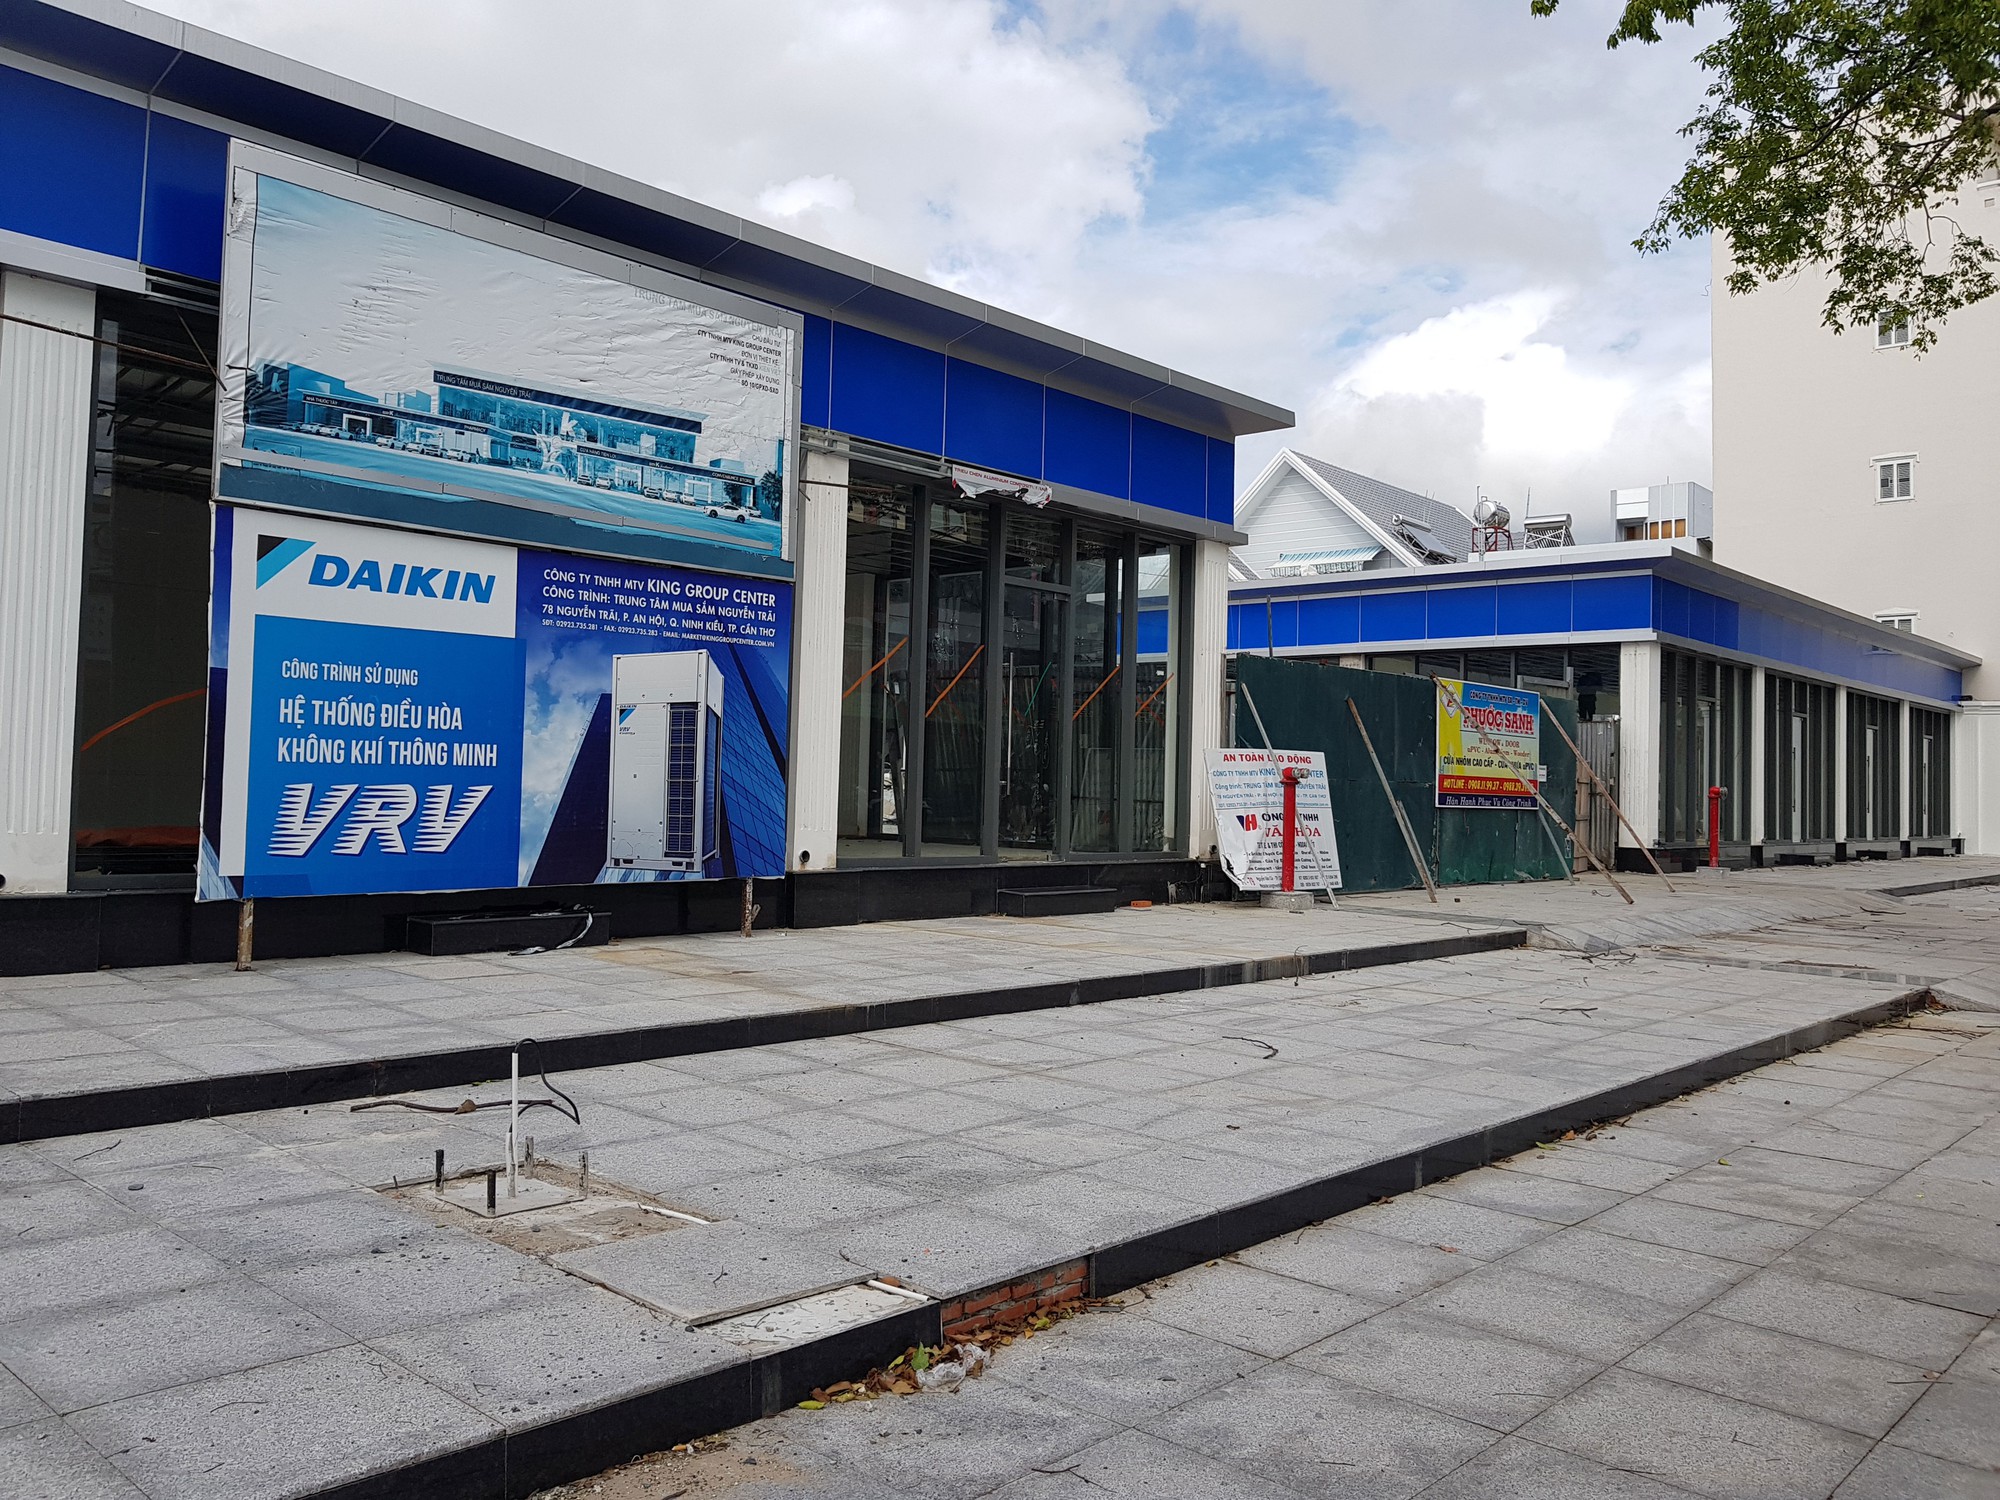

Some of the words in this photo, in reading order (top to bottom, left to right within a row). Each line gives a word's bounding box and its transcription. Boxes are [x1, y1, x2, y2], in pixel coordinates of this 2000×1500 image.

[732, 338, 745, 347] KING
[746, 342, 762, 351] GROUP
[763, 347, 782, 357] CENTER
[437, 374, 456, 384] TRUNG
[308, 554, 496, 604] DAIKIN
[544, 568, 576, 583] CÔNG
[579, 573, 591, 585] TY
[594, 576, 621, 588] TNHH
[624, 579, 645, 591] MTV
[647, 579, 681, 595] KING
[685, 584, 729, 601] GROUP
[733, 589, 776, 607] CENTER
[543, 585, 575, 600] CÔNG
[578, 589, 611, 604] TRÌNH:
[614, 594, 647, 607] TRUNG
[650, 597, 669, 610] TÂM
[672, 601, 693, 613] MUA
[696, 601, 716, 616] SẮM
[718, 606, 755, 620] NGUYỄN
[758, 611, 776, 623] TRÃI
[542, 604, 554, 615] 78
[557, 605, 596, 619] NGUYỄN
[599, 609, 621, 623] TRÃI,
[623, 612, 630, 623] P.
[633, 614, 646, 624] AN
[649, 614, 667, 629] HỘI,
[670, 617, 679, 628] Q.
[682, 619, 704, 630] NINH
[728, 624, 738, 634] TP.
[740, 623, 757, 636] CẦN
[759, 628, 776, 638] THƠ
[556, 621, 598, 631] 02923.735.281
[604, 625, 617, 633] FAX:
[618, 626, 658, 637] 02923.735.283
[663, 631, 681, 639] EMAIL:
[282, 658, 318, 680] CÔNG
[322, 661, 362, 683] TRÌNH
[365, 662, 382, 685] SỬ
[385, 667, 419, 688] DỤNG
[279, 694, 306, 729] HỆ
[311, 695, 376, 728] THỐNG
[380, 698, 422, 729] ĐIỀU
[427, 702, 463, 731] HÒA
[1505, 711, 1535, 732] SANH
[277, 733, 345, 765] KHÔNG
[351, 736, 385, 765] KHÍ
[389, 737, 448, 766] THÔNG
[452, 743, 498, 767] MINH
[1505, 740, 1520, 748] DOOR
[1224, 754, 1237, 762] AN
[1239, 752, 1265, 762] TOÀN
[1287, 754, 1312, 765] ĐỘNG
[1472, 759, 1483, 768] CAO
[1484, 757, 1494, 768] CẤP
[1213, 769, 1228, 777] CÔNG
[1259, 768, 1276, 776] KING
[1443, 779, 1465, 789] HOTLINE
[266, 782, 495, 858] VRV
